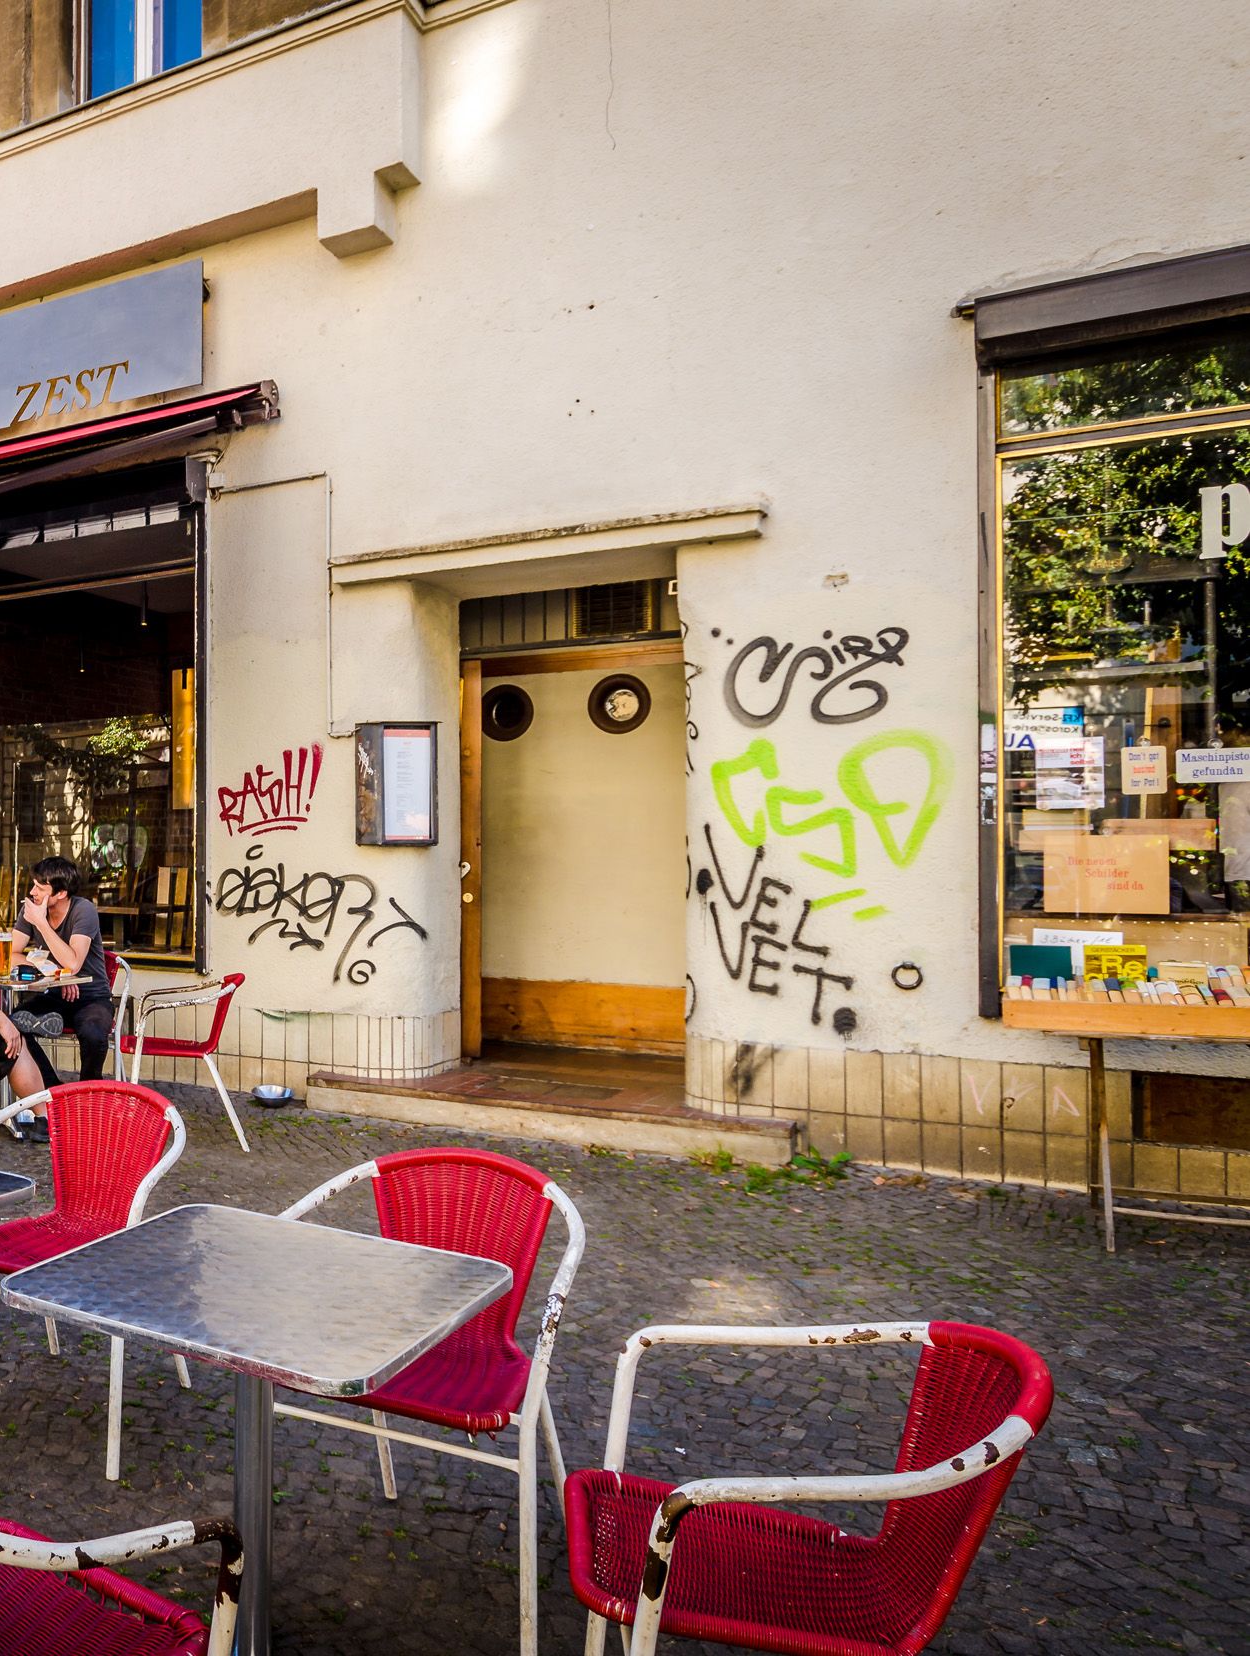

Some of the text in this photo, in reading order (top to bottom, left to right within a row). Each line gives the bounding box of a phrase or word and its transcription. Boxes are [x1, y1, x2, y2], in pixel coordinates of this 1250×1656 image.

[9, 360, 129, 427] ZEST
[1128, 753, 1159, 762] Don't get
[1068, 856, 1117, 866] Die neuen
[1085, 868, 1129, 878] Schilder
[1107, 880, 1144, 890] sind da
